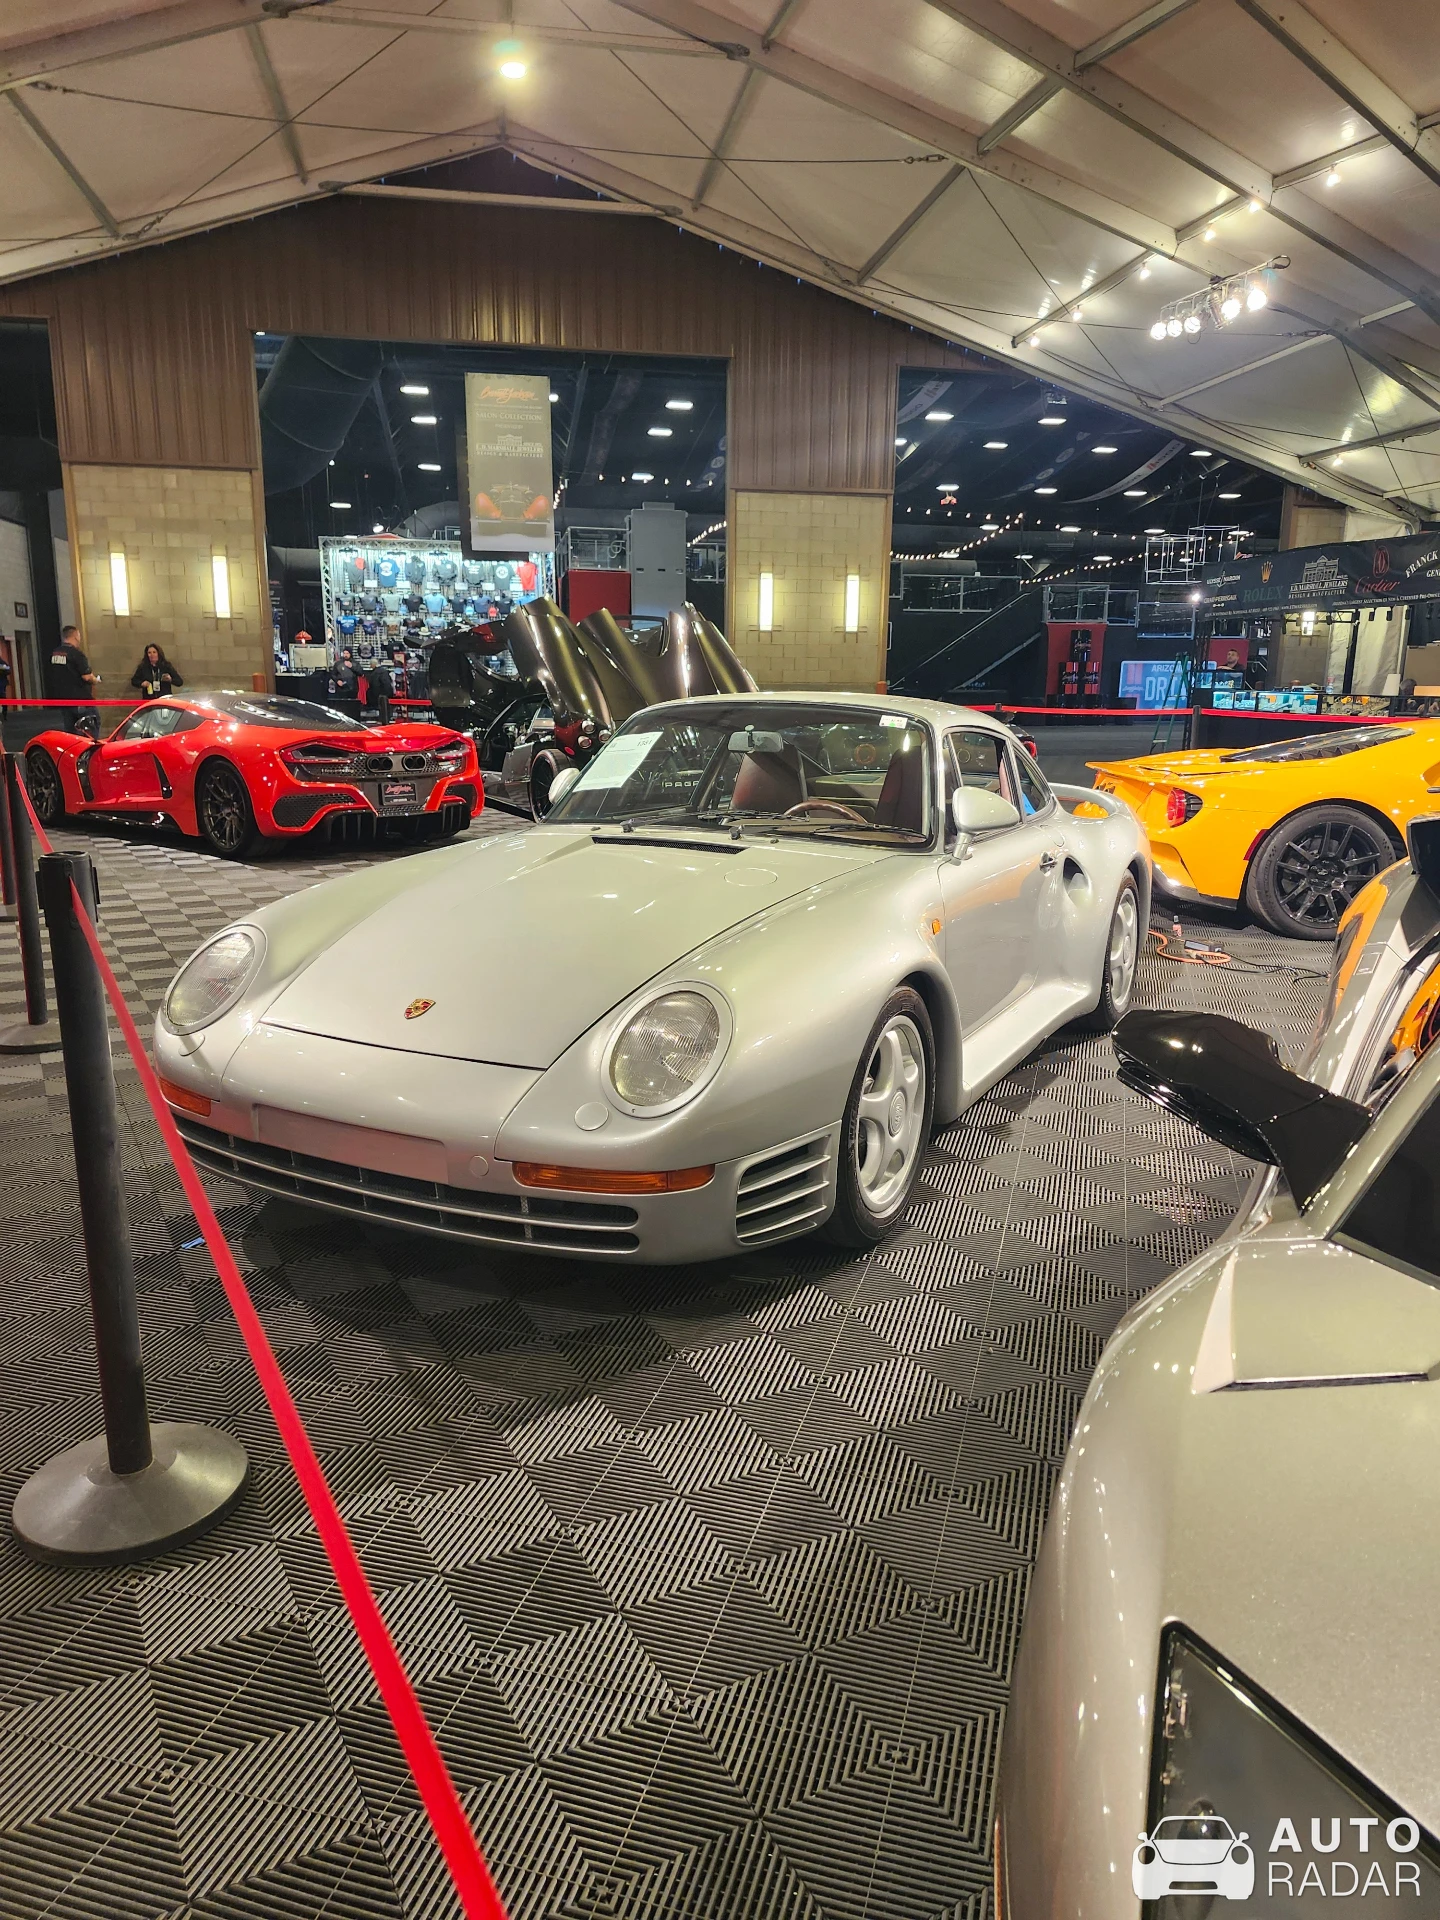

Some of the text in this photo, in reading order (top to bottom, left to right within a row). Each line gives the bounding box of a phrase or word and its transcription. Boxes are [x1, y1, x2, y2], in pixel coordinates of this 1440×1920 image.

[1405, 550, 1439, 578] FRANCK
[1243, 586, 1283, 602] ROLEX
[1355, 576, 1400, 594] Cartier
